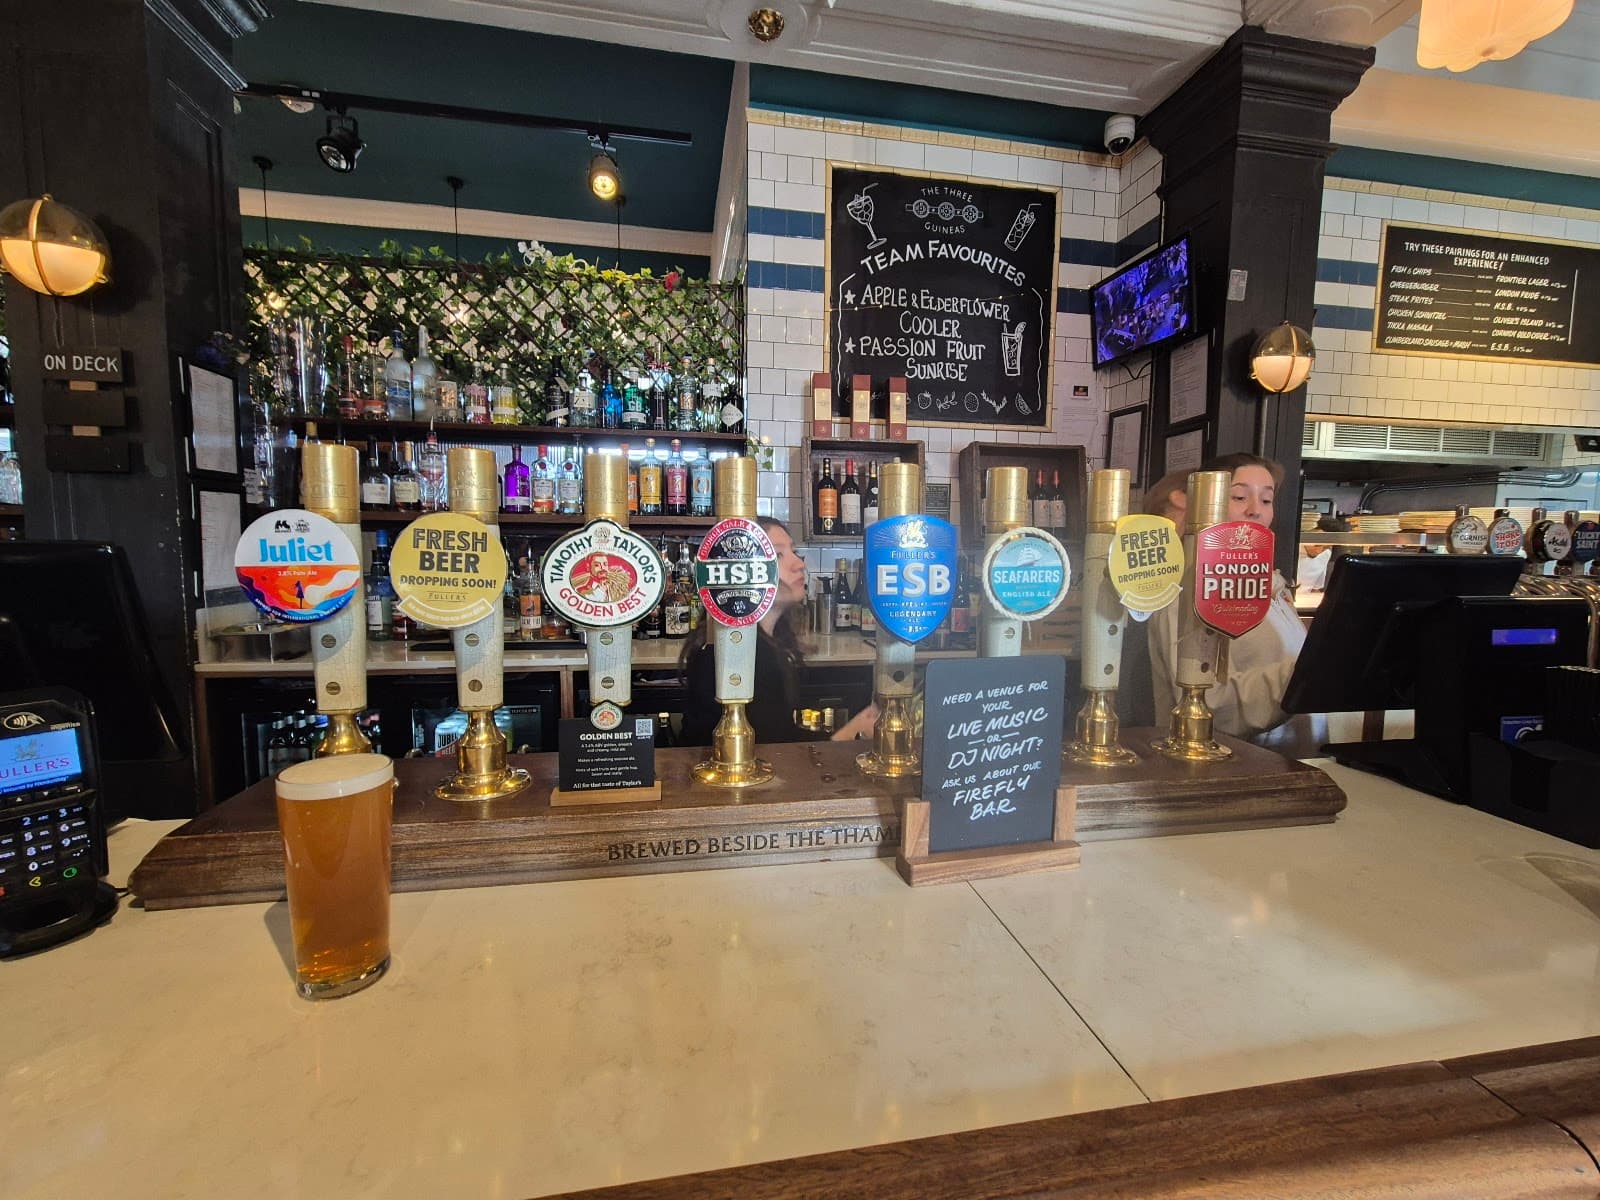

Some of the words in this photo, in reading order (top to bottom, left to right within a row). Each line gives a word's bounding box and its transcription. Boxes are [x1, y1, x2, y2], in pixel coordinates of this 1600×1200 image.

[921, 187, 940, 197] THE
[944, 187, 974, 202] THREE
[924, 222, 966, 234] GUINEAS
[860, 243, 924, 275] TEAM
[928, 239, 1026, 287] FAVOURITES
[1404, 242, 1420, 251] TRY
[1421, 243, 1444, 254] THESE
[1445, 246, 1480, 258] PAIRINGS
[1481, 250, 1495, 259] FOR
[1497, 252, 1508, 261] AN
[1511, 253, 1550, 266] ENHANCED
[1391, 265, 1407, 273] FISH
[1412, 268, 1433, 276] CHIPS
[1454, 257, 1504, 271] EXPERIENCE!
[1390, 281, 1440, 292] CHEESEBURGER
[1496, 275, 1527, 285] FRONTIER
[1528, 278, 1550, 287] LAGER
[860, 284, 907, 307] APPLE
[911, 293, 919, 308] &
[920, 289, 1011, 322] ELDERFLOWER
[1388, 294, 1410, 303] STEAK
[1410, 296, 1434, 305] FRITES
[1495, 289, 1520, 298] LONDON
[1520, 291, 1541, 300] PRIDE
[1387, 308, 1414, 317] CHICKEN
[1520, 318, 1543, 326] ISLAND
[899, 310, 962, 339] COOLER
[1387, 321, 1405, 330] TIKKA
[1406, 323, 1433, 332] MASALA
[859, 336, 936, 357] PASSION
[946, 340, 986, 361] FRUIT
[1385, 336, 1424, 345] CUMBERLAND
[1452, 341, 1472, 350] MASH
[44, 354, 66, 370] ON
[73, 355, 118, 372] DECK
[905, 358, 968, 382] SUNRISE
[412, 528, 488, 553] FRESH
[1120, 527, 1170, 552] FRESH
[259, 537, 333, 562] Juliet
[891, 551, 936, 560] FULLER'S
[1127, 546, 1168, 569] BEER
[1220, 551, 1258, 560] FULLER'S
[419, 551, 480, 574] BEER
[550, 535, 593, 583] TIMOTHY
[612, 535, 656, 584] TAYLOR'S
[1204, 562, 1270, 575] LONDON
[400, 575, 459, 587] DROPPING
[461, 578, 497, 589] SOON!
[706, 561, 768, 585] HSB
[877, 563, 951, 597] ESB
[994, 570, 1060, 584] SEAFARERS
[1118, 569, 1156, 584] DROPPING
[1157, 564, 1180, 576] SOON!
[1203, 577, 1269, 599] PRIDE
[560, 588, 614, 617] GOLDEN
[617, 587, 647, 614] BEST
[942, 692, 972, 706] NEED
[975, 690, 984, 700] A
[987, 684, 1024, 698] VENUE
[1028, 680, 1049, 693] FOR
[982, 700, 1013, 714] YOUR
[947, 719, 984, 740] LIVE
[984, 706, 1049, 733] MUSIC
[579, 732, 613, 741] GOLDEN
[614, 731, 633, 739] BEST
[986, 734, 1001, 743] OR
[947, 748, 979, 770] DJ
[980, 736, 1044, 763] NIGHT?
[0, 758, 70, 778] ULLER'S
[942, 777, 961, 789] ASK
[964, 774, 977, 785] US
[983, 764, 1019, 781] ABOUT
[1022, 760, 1042, 772] OUR
[953, 774, 1031, 806] FIREFLY
[969, 798, 1017, 821] BAR
[22, 816, 31, 826] 2
[60, 823, 70, 832] 6
[61, 838, 71, 847] 9
[607, 837, 701, 862] BREWED
[707, 832, 780, 854] BESIDE
[786, 828, 825, 849] THE
[831, 824, 895, 846] THAM
[28, 861, 39, 871] 0
